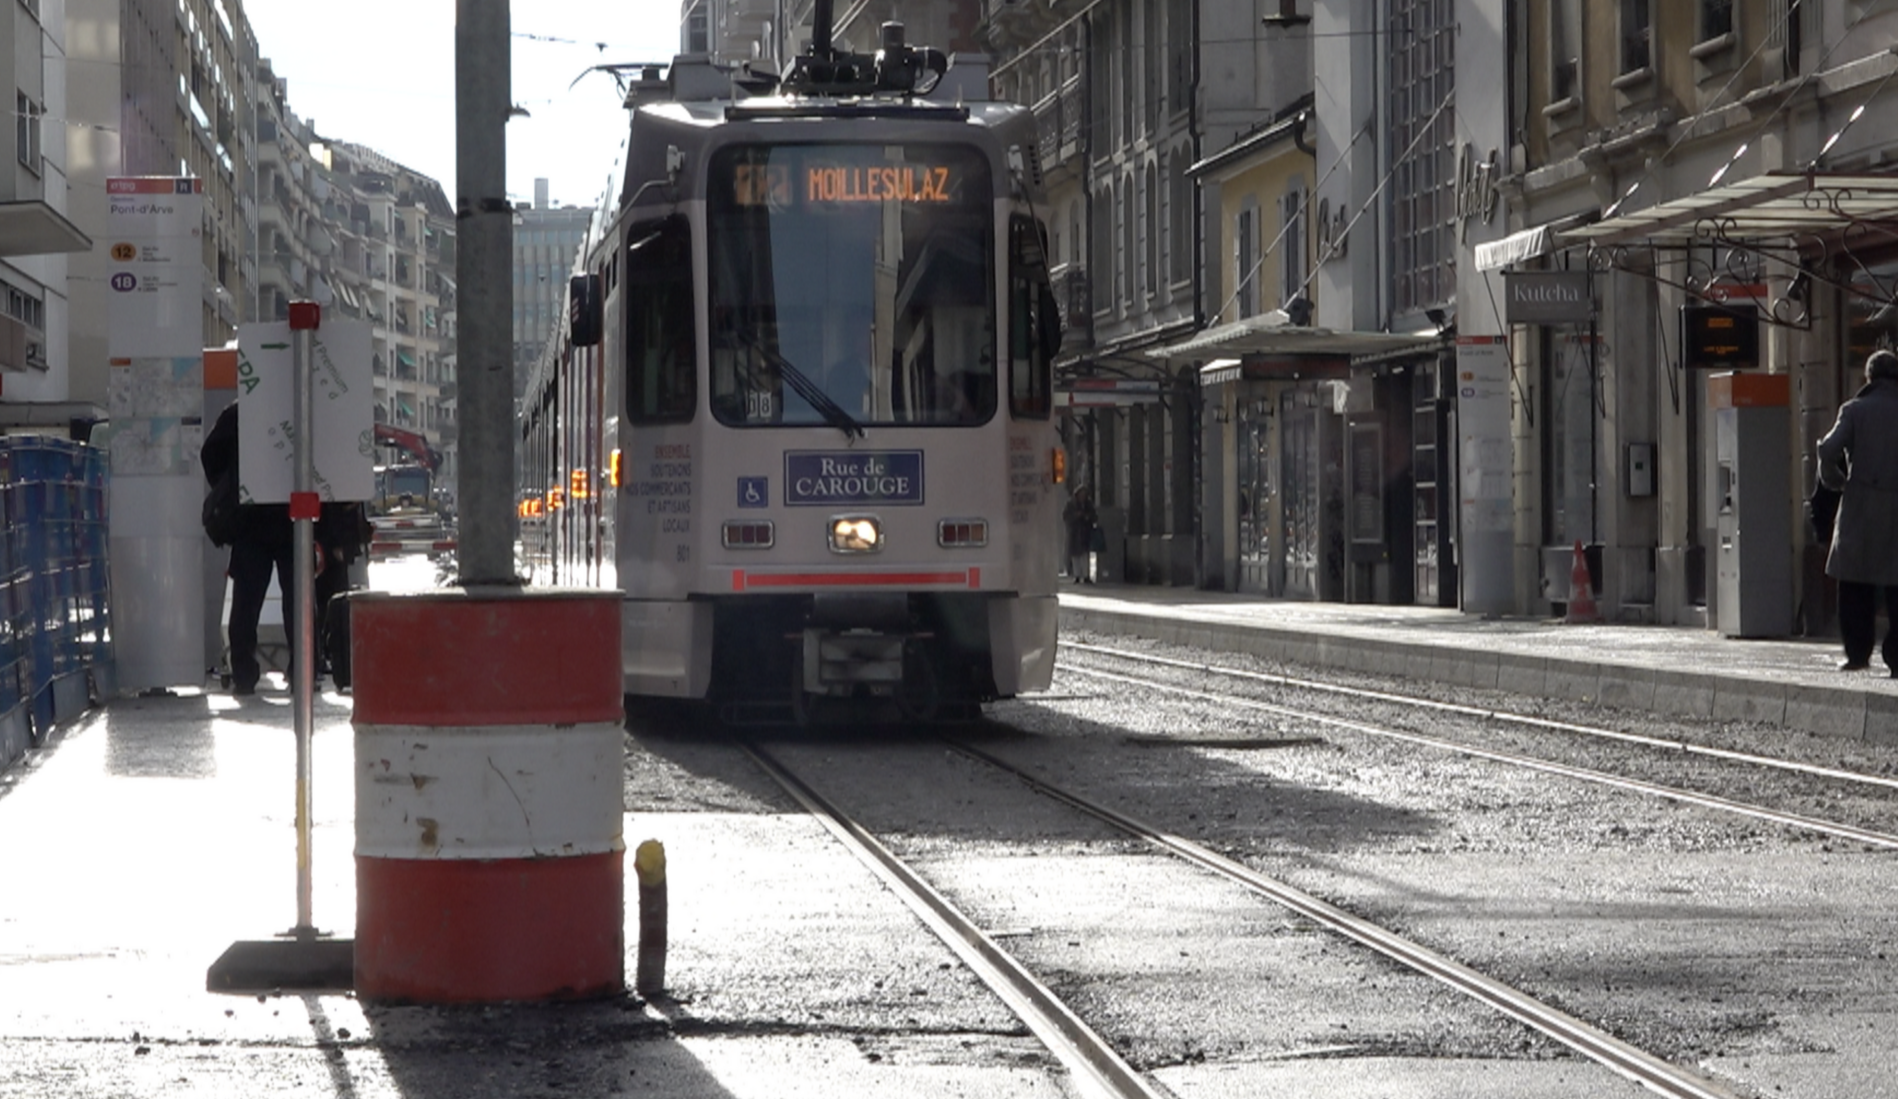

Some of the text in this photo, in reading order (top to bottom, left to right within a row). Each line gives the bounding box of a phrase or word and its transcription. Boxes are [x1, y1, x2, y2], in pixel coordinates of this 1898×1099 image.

[809, 167, 949, 201] MOILLESULAZ
[110, 204, 173, 216] Pont-d'Arve
[116, 246, 132, 258] 12
[114, 276, 133, 289] 18
[1514, 284, 1579, 302] Kutcha
[650, 463, 691, 478] SOUTENONS
[821, 457, 885, 477] Rue de
[796, 477, 910, 496] CAROUGE
[657, 499, 691, 514] ARTISANS
[663, 518, 690, 533] LOCAUX
